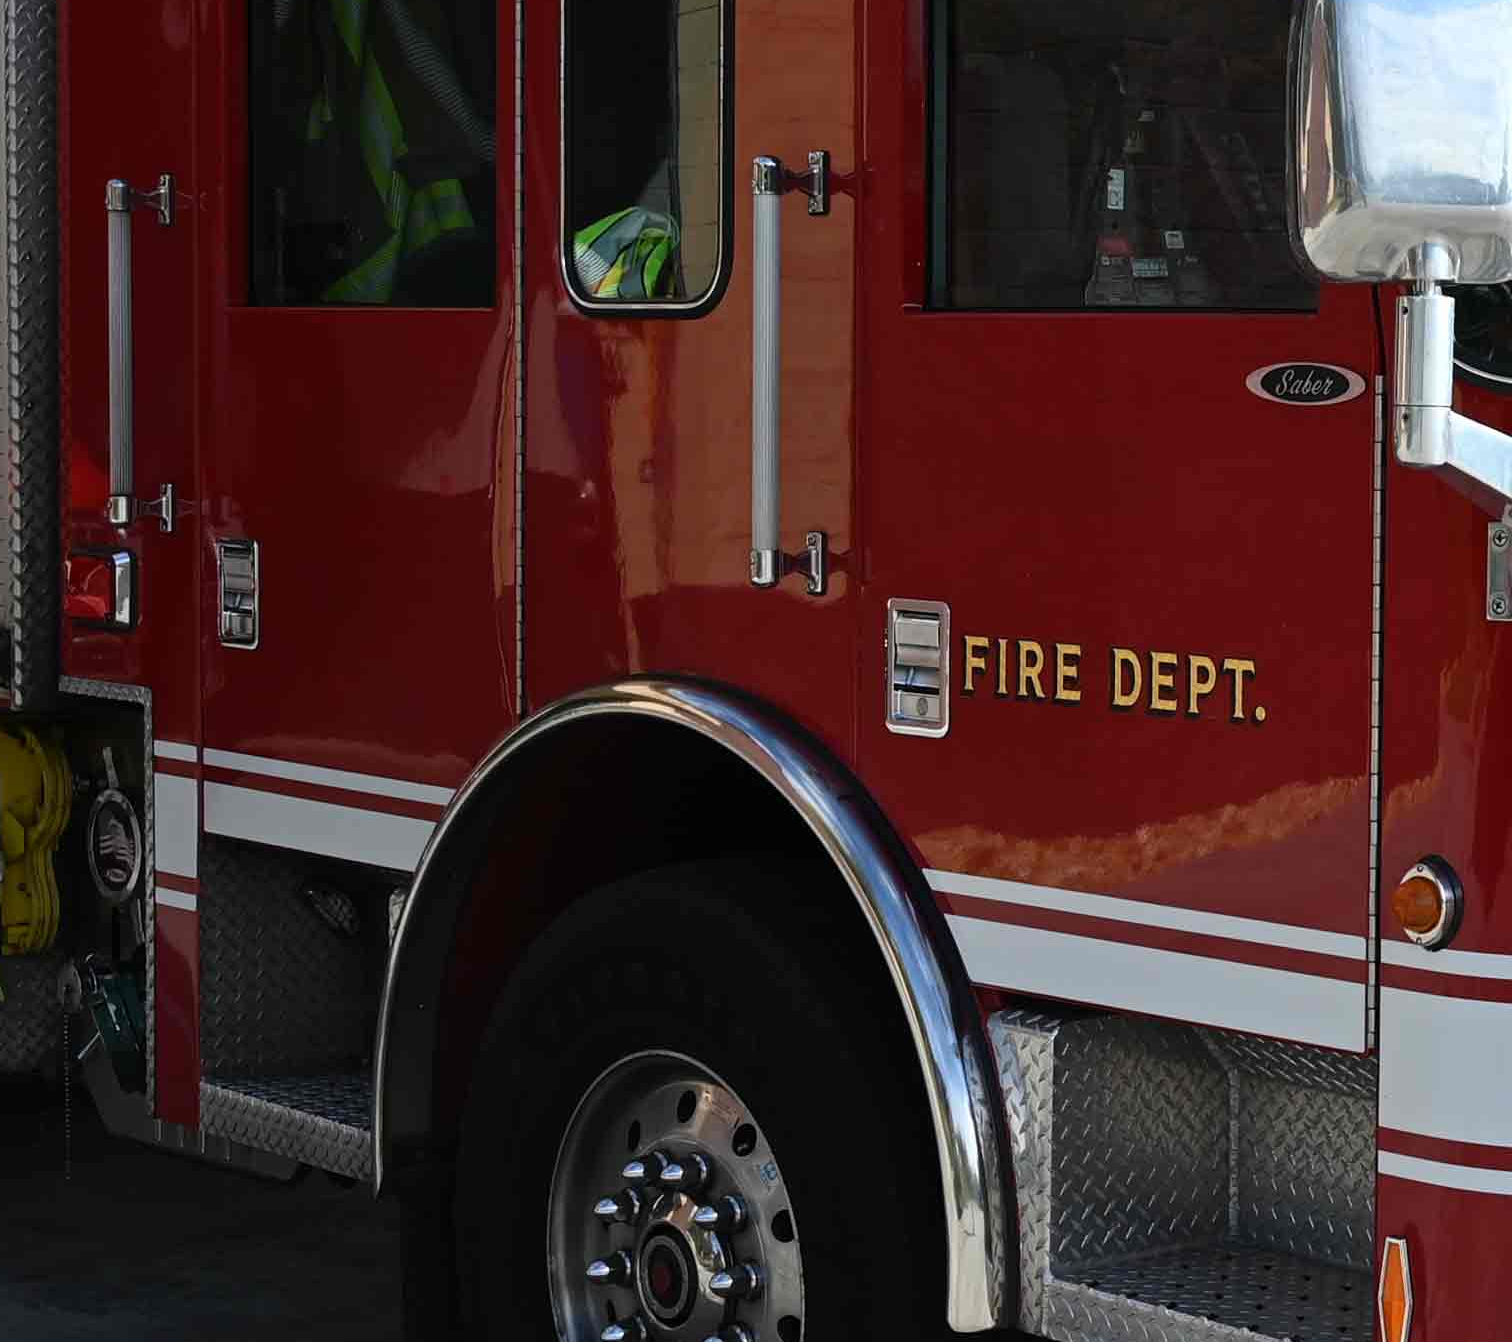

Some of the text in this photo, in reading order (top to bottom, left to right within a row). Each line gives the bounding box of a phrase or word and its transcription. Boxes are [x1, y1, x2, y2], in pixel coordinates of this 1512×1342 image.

[1274, 368, 1335, 397] Saber
[962, 634, 1268, 723] FIRE DEPT.
